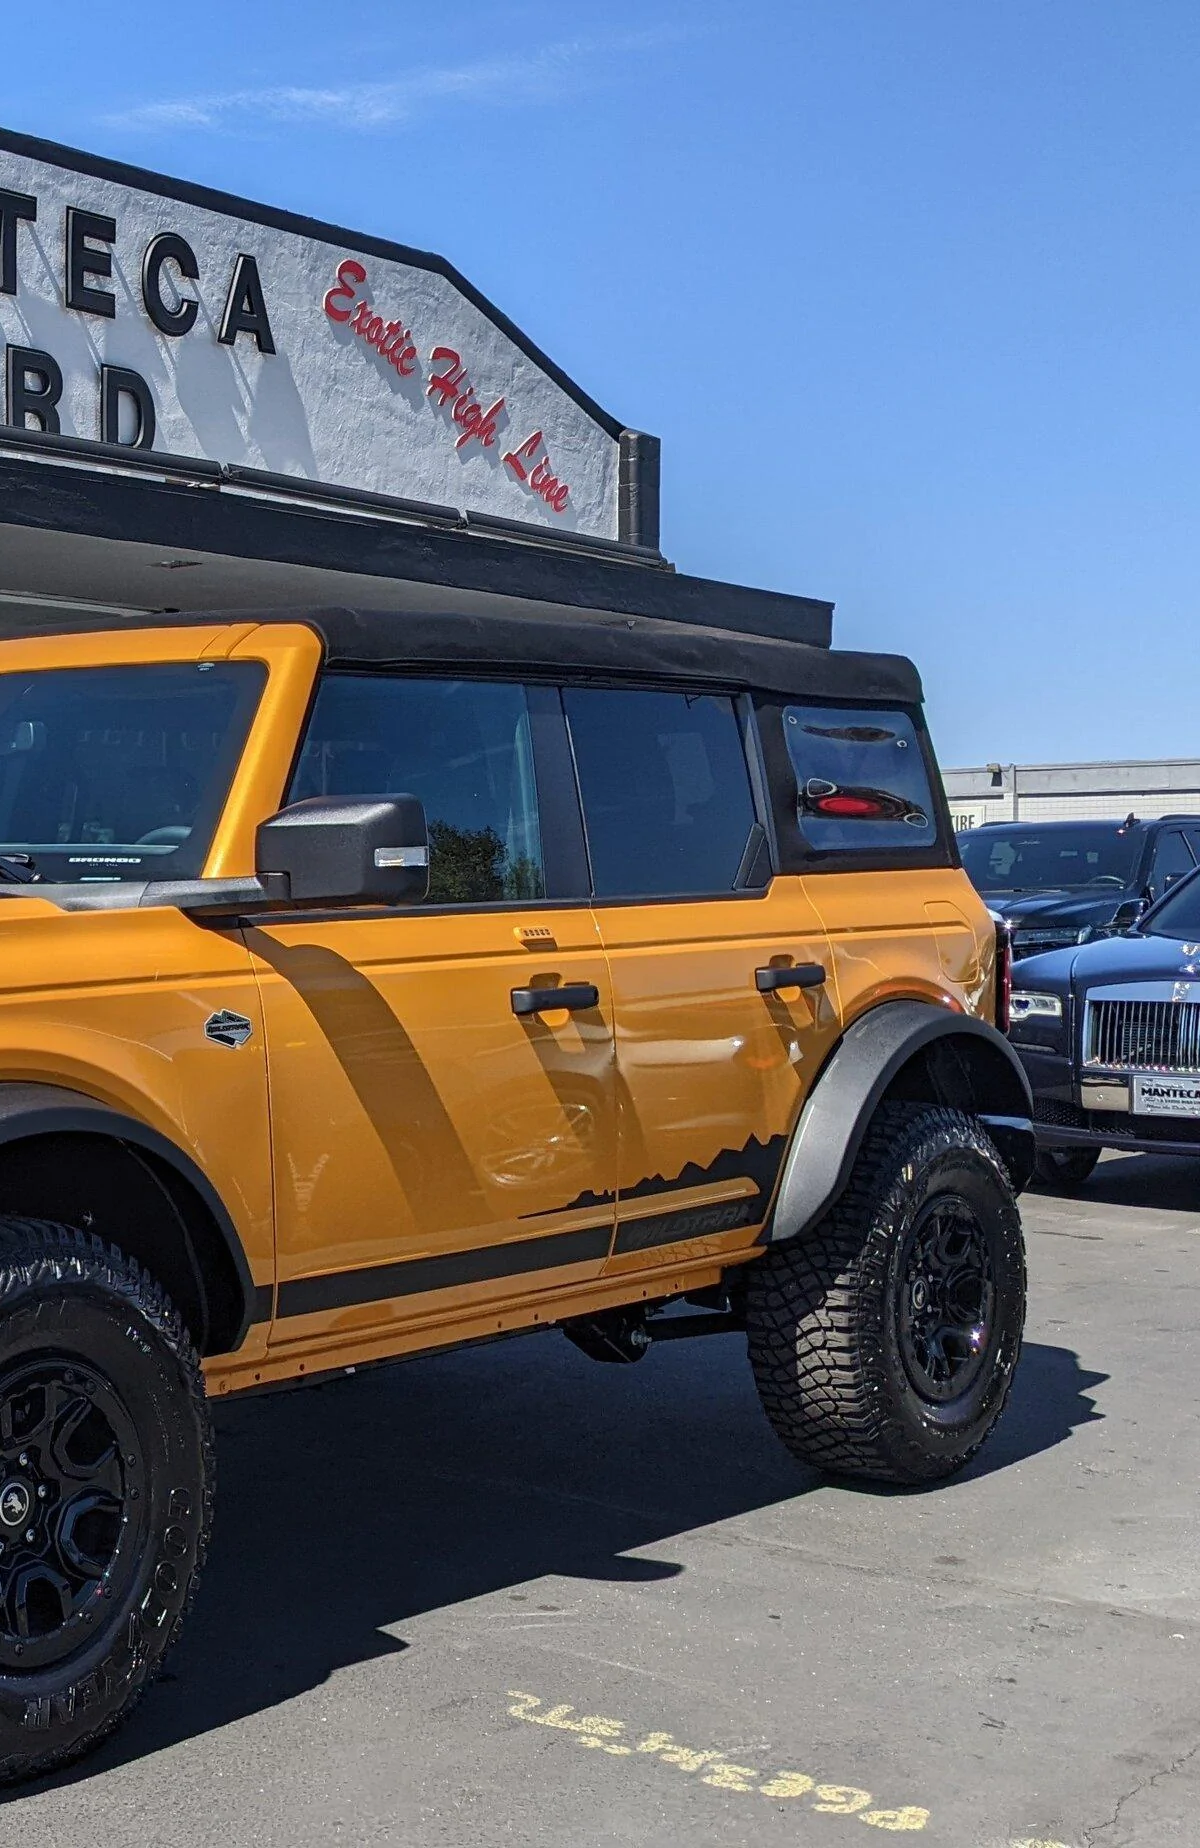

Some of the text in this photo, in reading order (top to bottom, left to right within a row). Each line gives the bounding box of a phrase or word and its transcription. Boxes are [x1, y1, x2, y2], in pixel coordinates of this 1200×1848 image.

[323, 258, 568, 513] Exotic High Line
